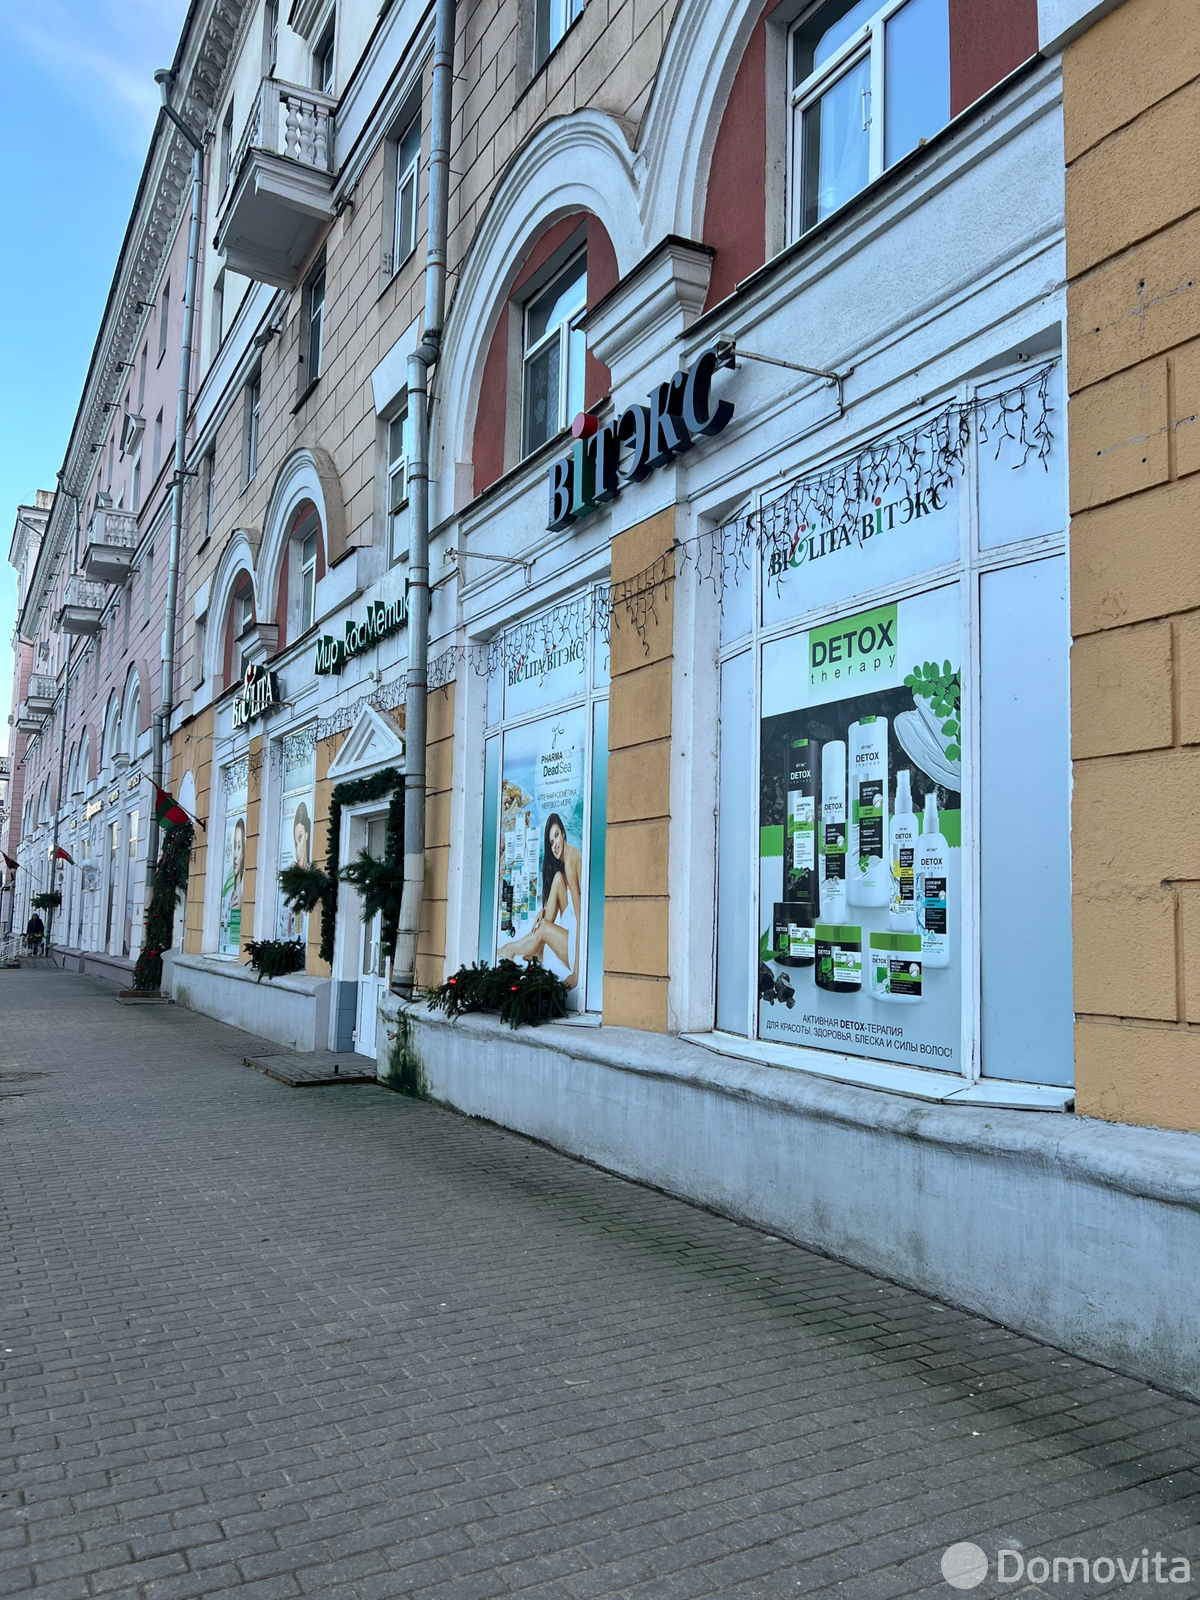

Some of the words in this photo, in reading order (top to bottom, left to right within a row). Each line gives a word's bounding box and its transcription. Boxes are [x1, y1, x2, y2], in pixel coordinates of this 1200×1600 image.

[313, 635, 343, 675] Мир
[812, 619, 894, 668] DETOX
[811, 654, 896, 685] therapy
[855, 752, 879, 763] DETOX
[790, 769, 811, 781] DETOX
[824, 802, 843, 811] DETOX
[920, 857, 943, 866] DETOX
[802, 1014, 839, 1028] АКТИВНАЯ
[840, 1019, 903, 1037] DETOX-ТЕРАПИЯ
[766, 1020, 779, 1030] ДЛЯ
[780, 1022, 813, 1037] КРАСОТЫ,
[813, 1027, 853, 1043] ЗДОРОВЬЯ,
[855, 1033, 885, 1048] БЛЕСКА
[886, 1039, 892, 1048] И
[894, 1040, 918, 1052] СИЛЫ
[920, 1044, 953, 1058] ВОЛОС!
